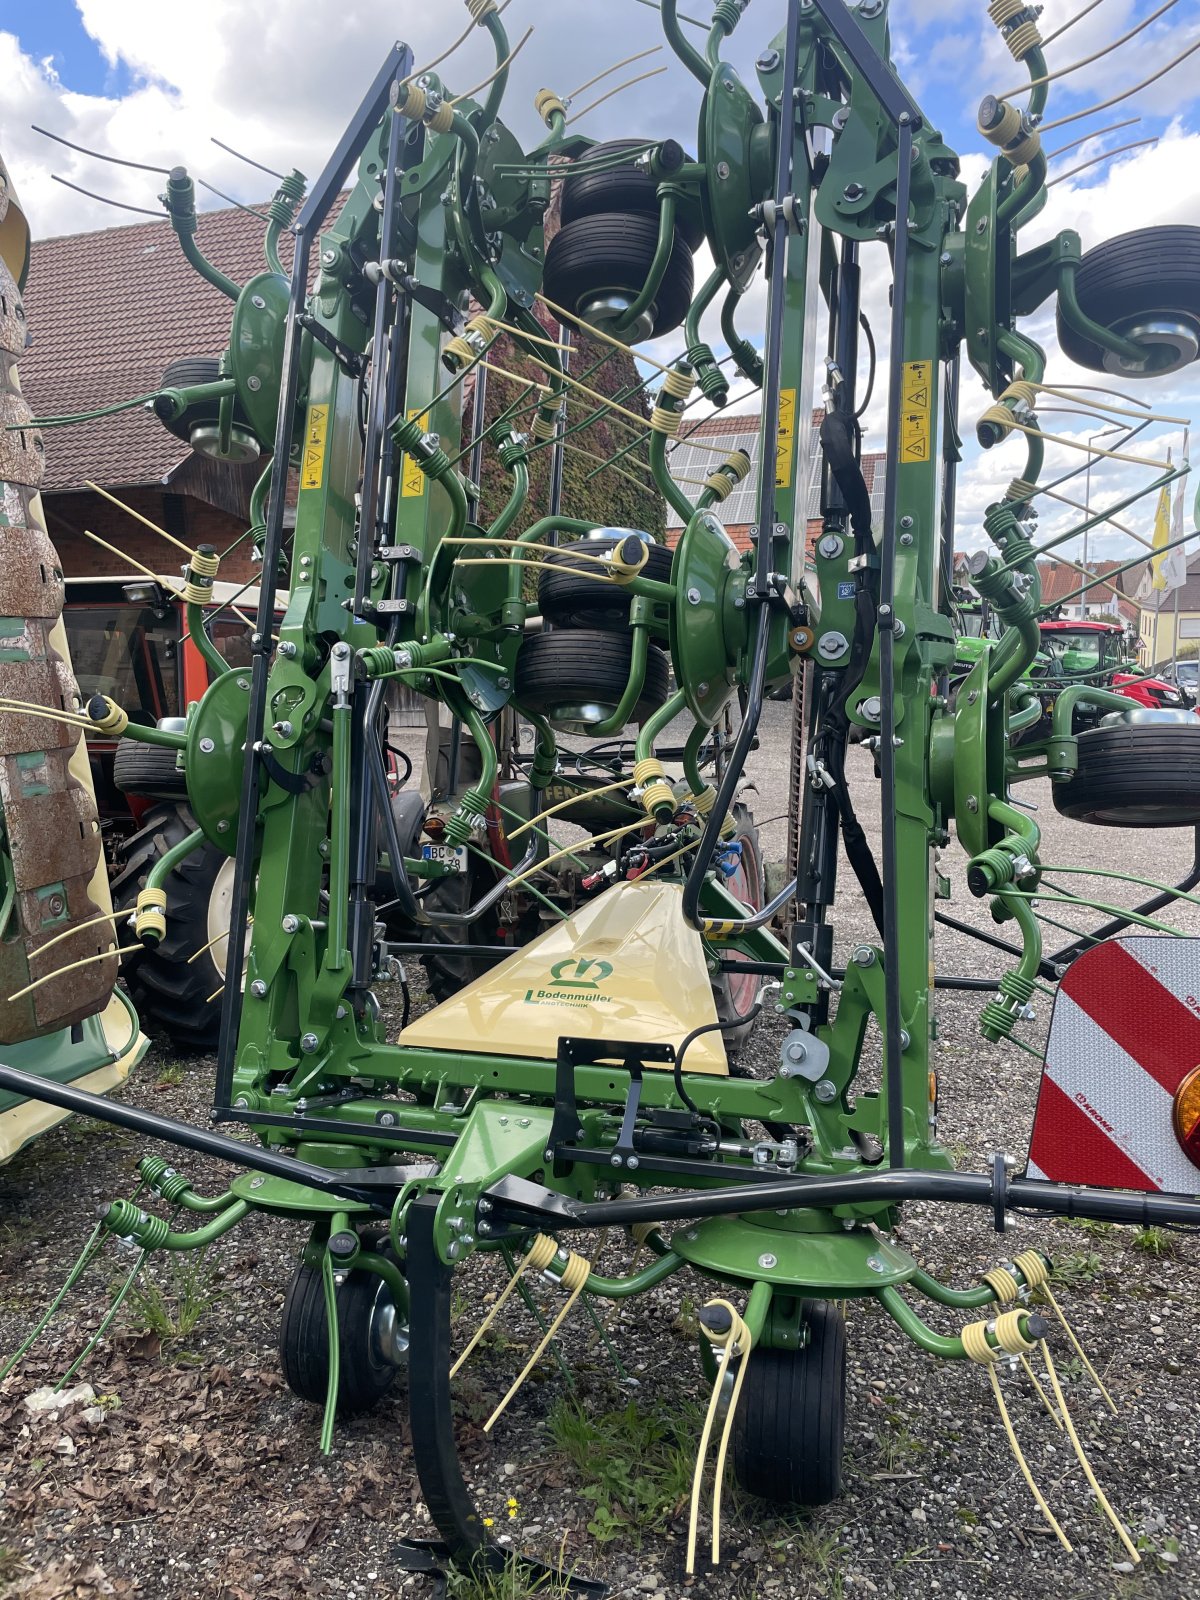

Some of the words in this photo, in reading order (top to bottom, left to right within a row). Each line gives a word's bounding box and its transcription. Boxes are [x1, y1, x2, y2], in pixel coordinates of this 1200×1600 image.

[431, 847, 445, 859] BC
[537, 990, 613, 1003] Bodenmüller
[1082, 1103, 1115, 1133] KRONE
